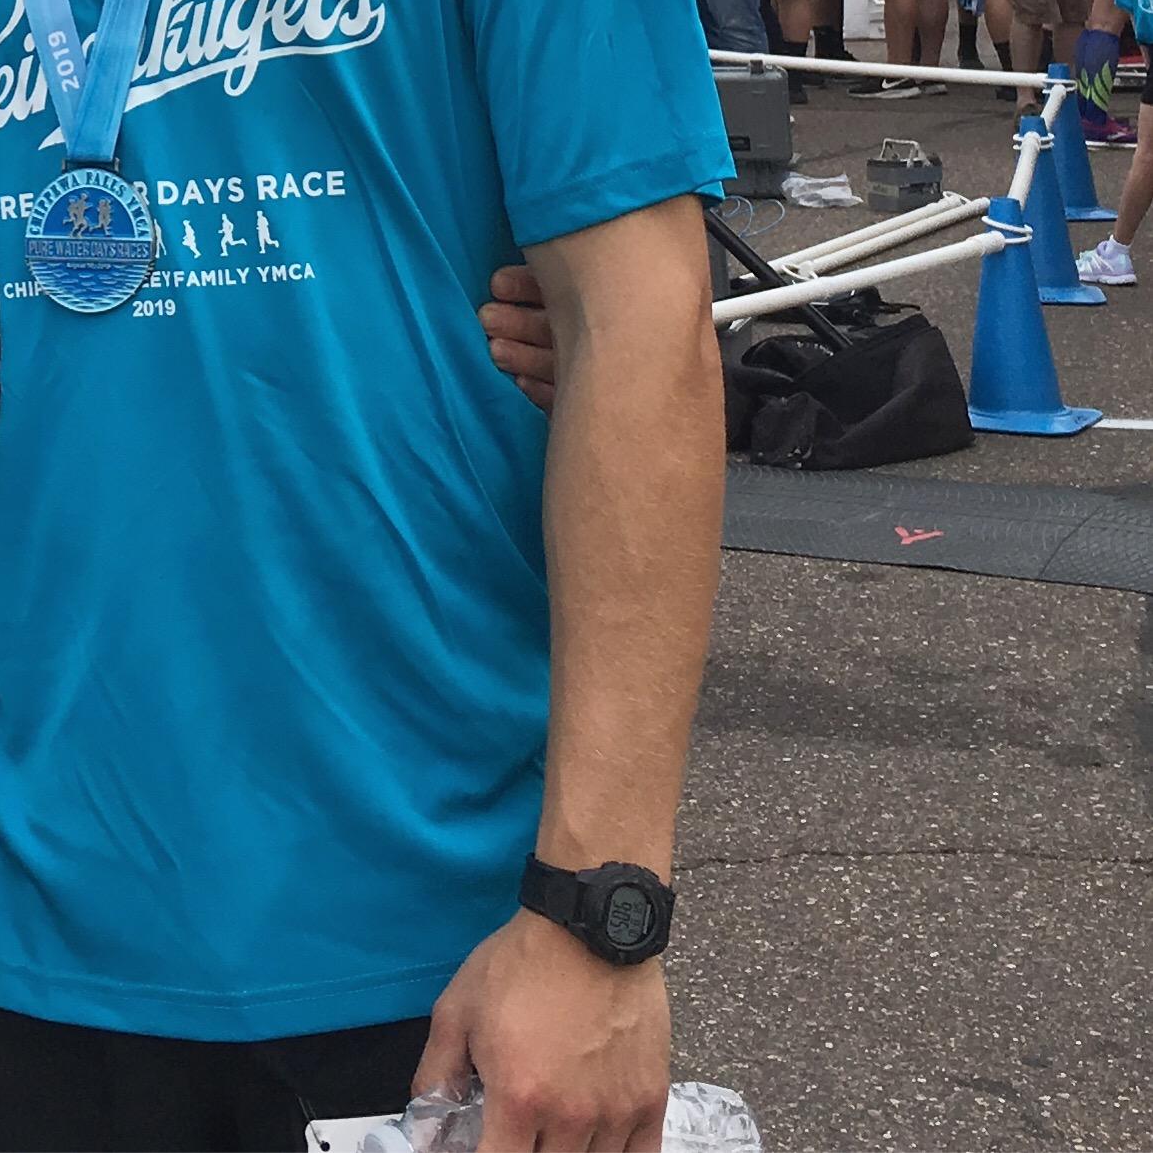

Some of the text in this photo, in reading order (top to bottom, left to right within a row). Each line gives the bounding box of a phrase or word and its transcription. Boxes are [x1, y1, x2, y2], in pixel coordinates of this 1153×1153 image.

[47, 30, 80, 93] 2019
[86, 171, 127, 196] FALLS
[157, 177, 245, 207] DAYS
[256, 170, 346, 201] RACE
[28, 240, 149, 259] PURE WATER DAYS RACES
[257, 261, 317, 283] YMCA
[132, 300, 177, 318] 2019
